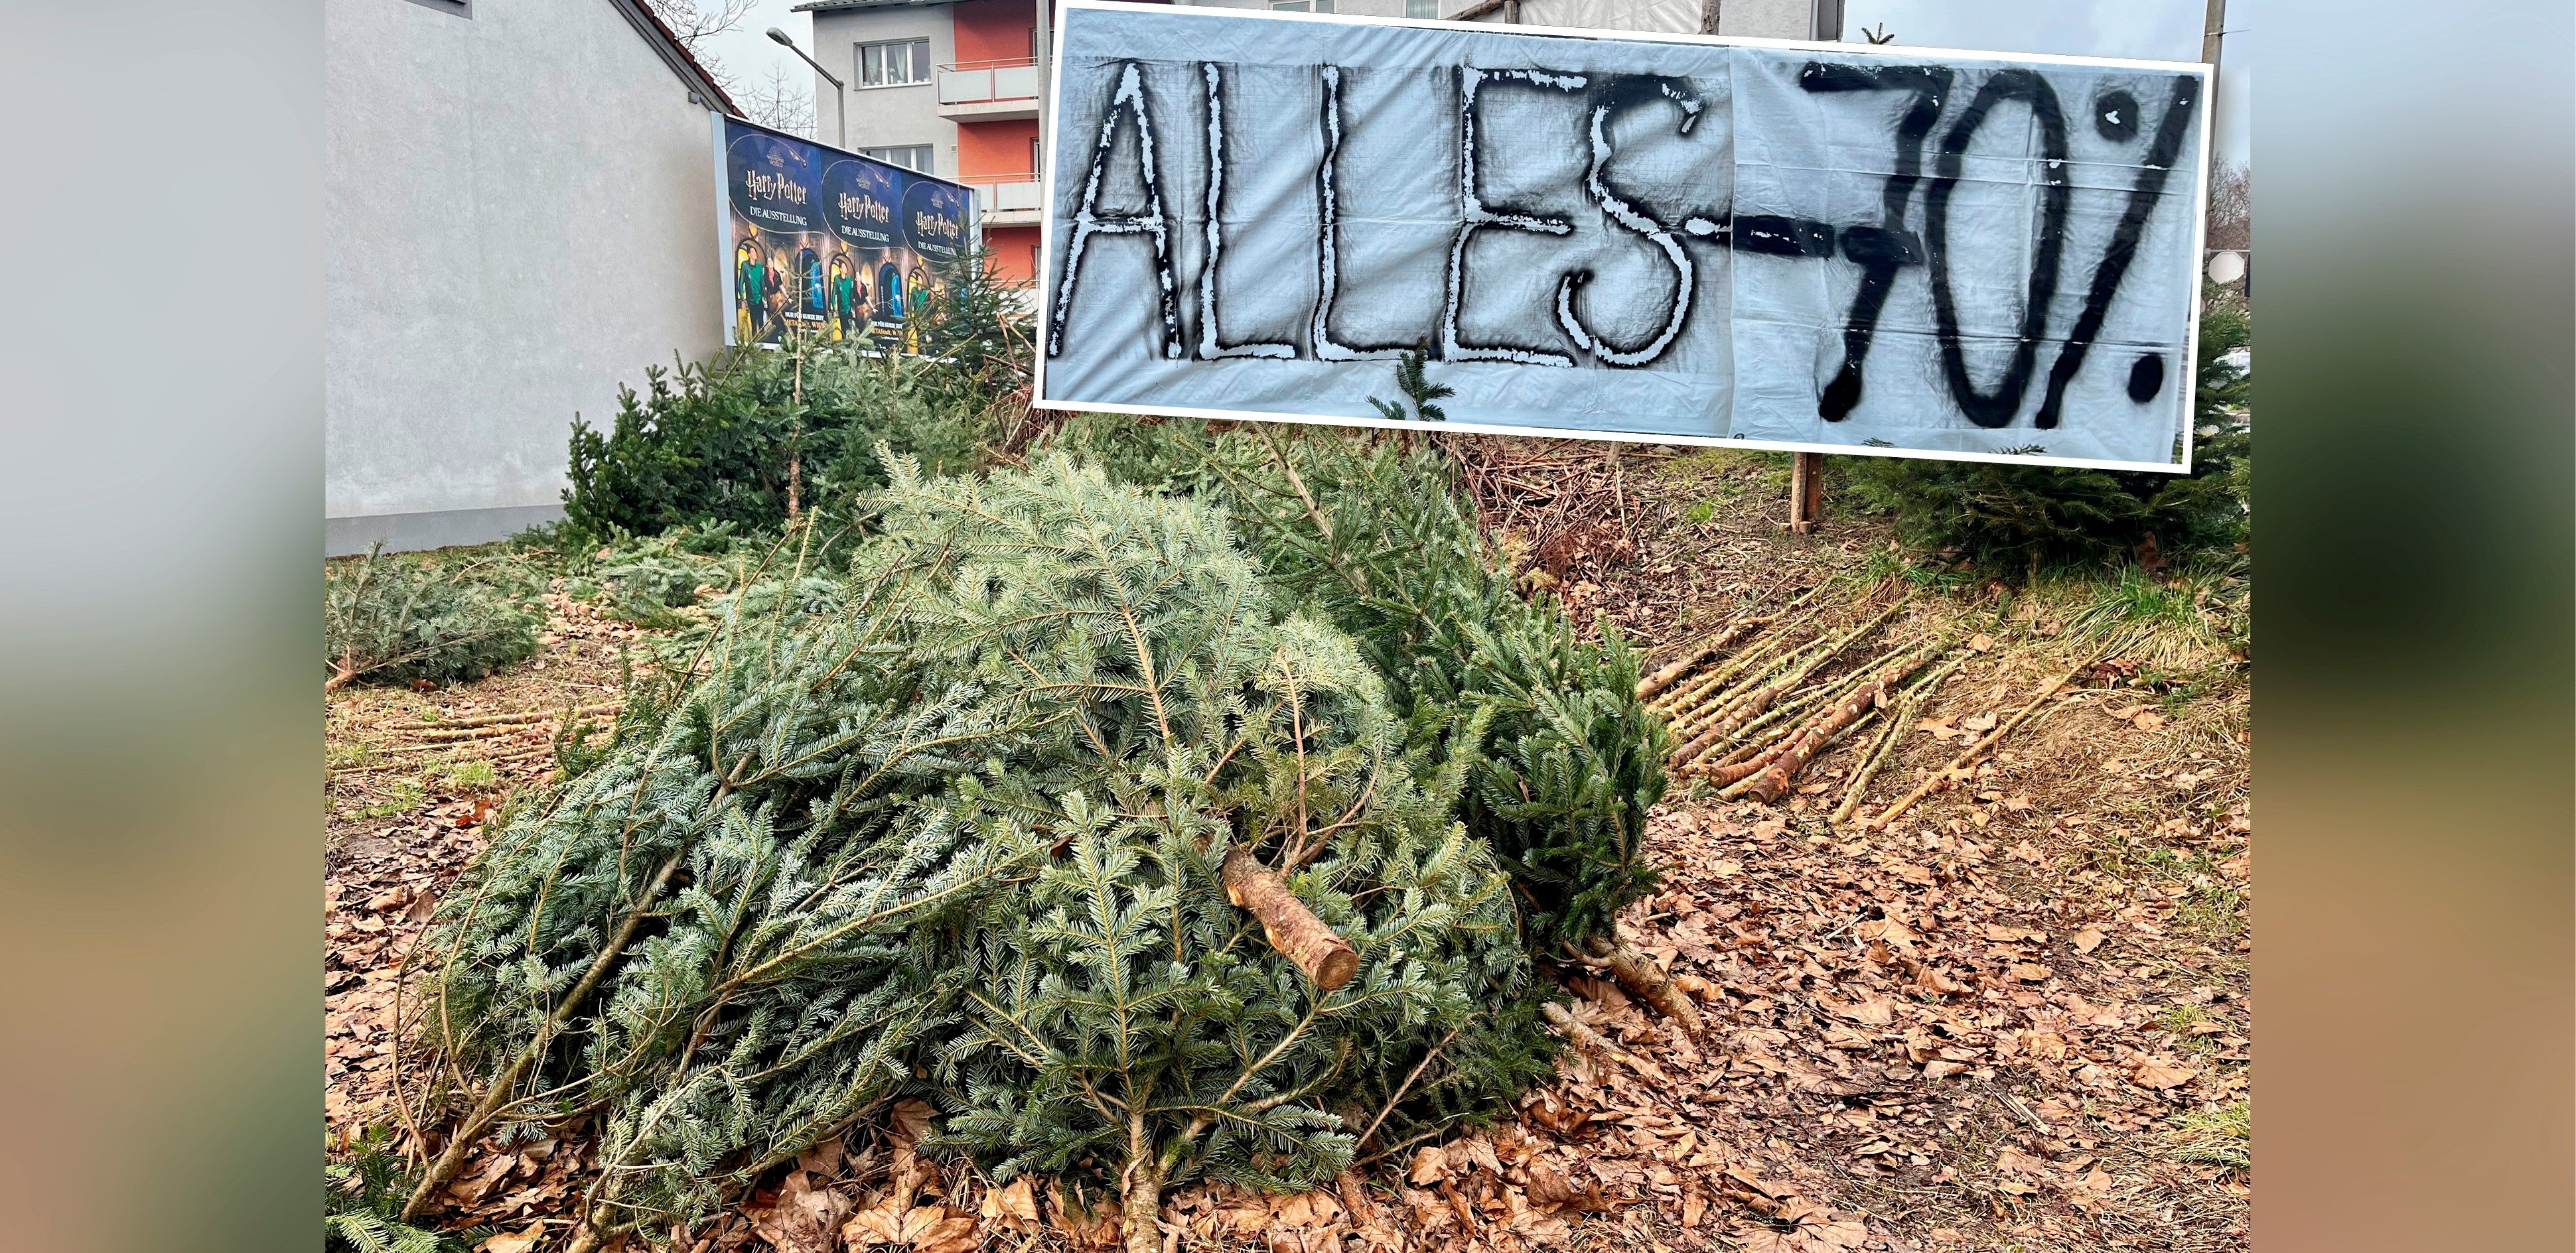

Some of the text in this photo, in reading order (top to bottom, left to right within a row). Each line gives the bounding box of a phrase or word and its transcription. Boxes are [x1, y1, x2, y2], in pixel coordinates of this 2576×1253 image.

[746, 170, 807, 206] Harry Potter
[750, 206, 807, 226] DIE AUSSTELLUNG
[838, 192, 889, 224] Harry Potter
[1046, 58, 1707, 370] ALLES
[841, 226, 889, 243] DIE AUSSTELLUNG
[916, 211, 959, 239] Harry Potter
[918, 241, 958, 257] DIE AUSSTELLUN
